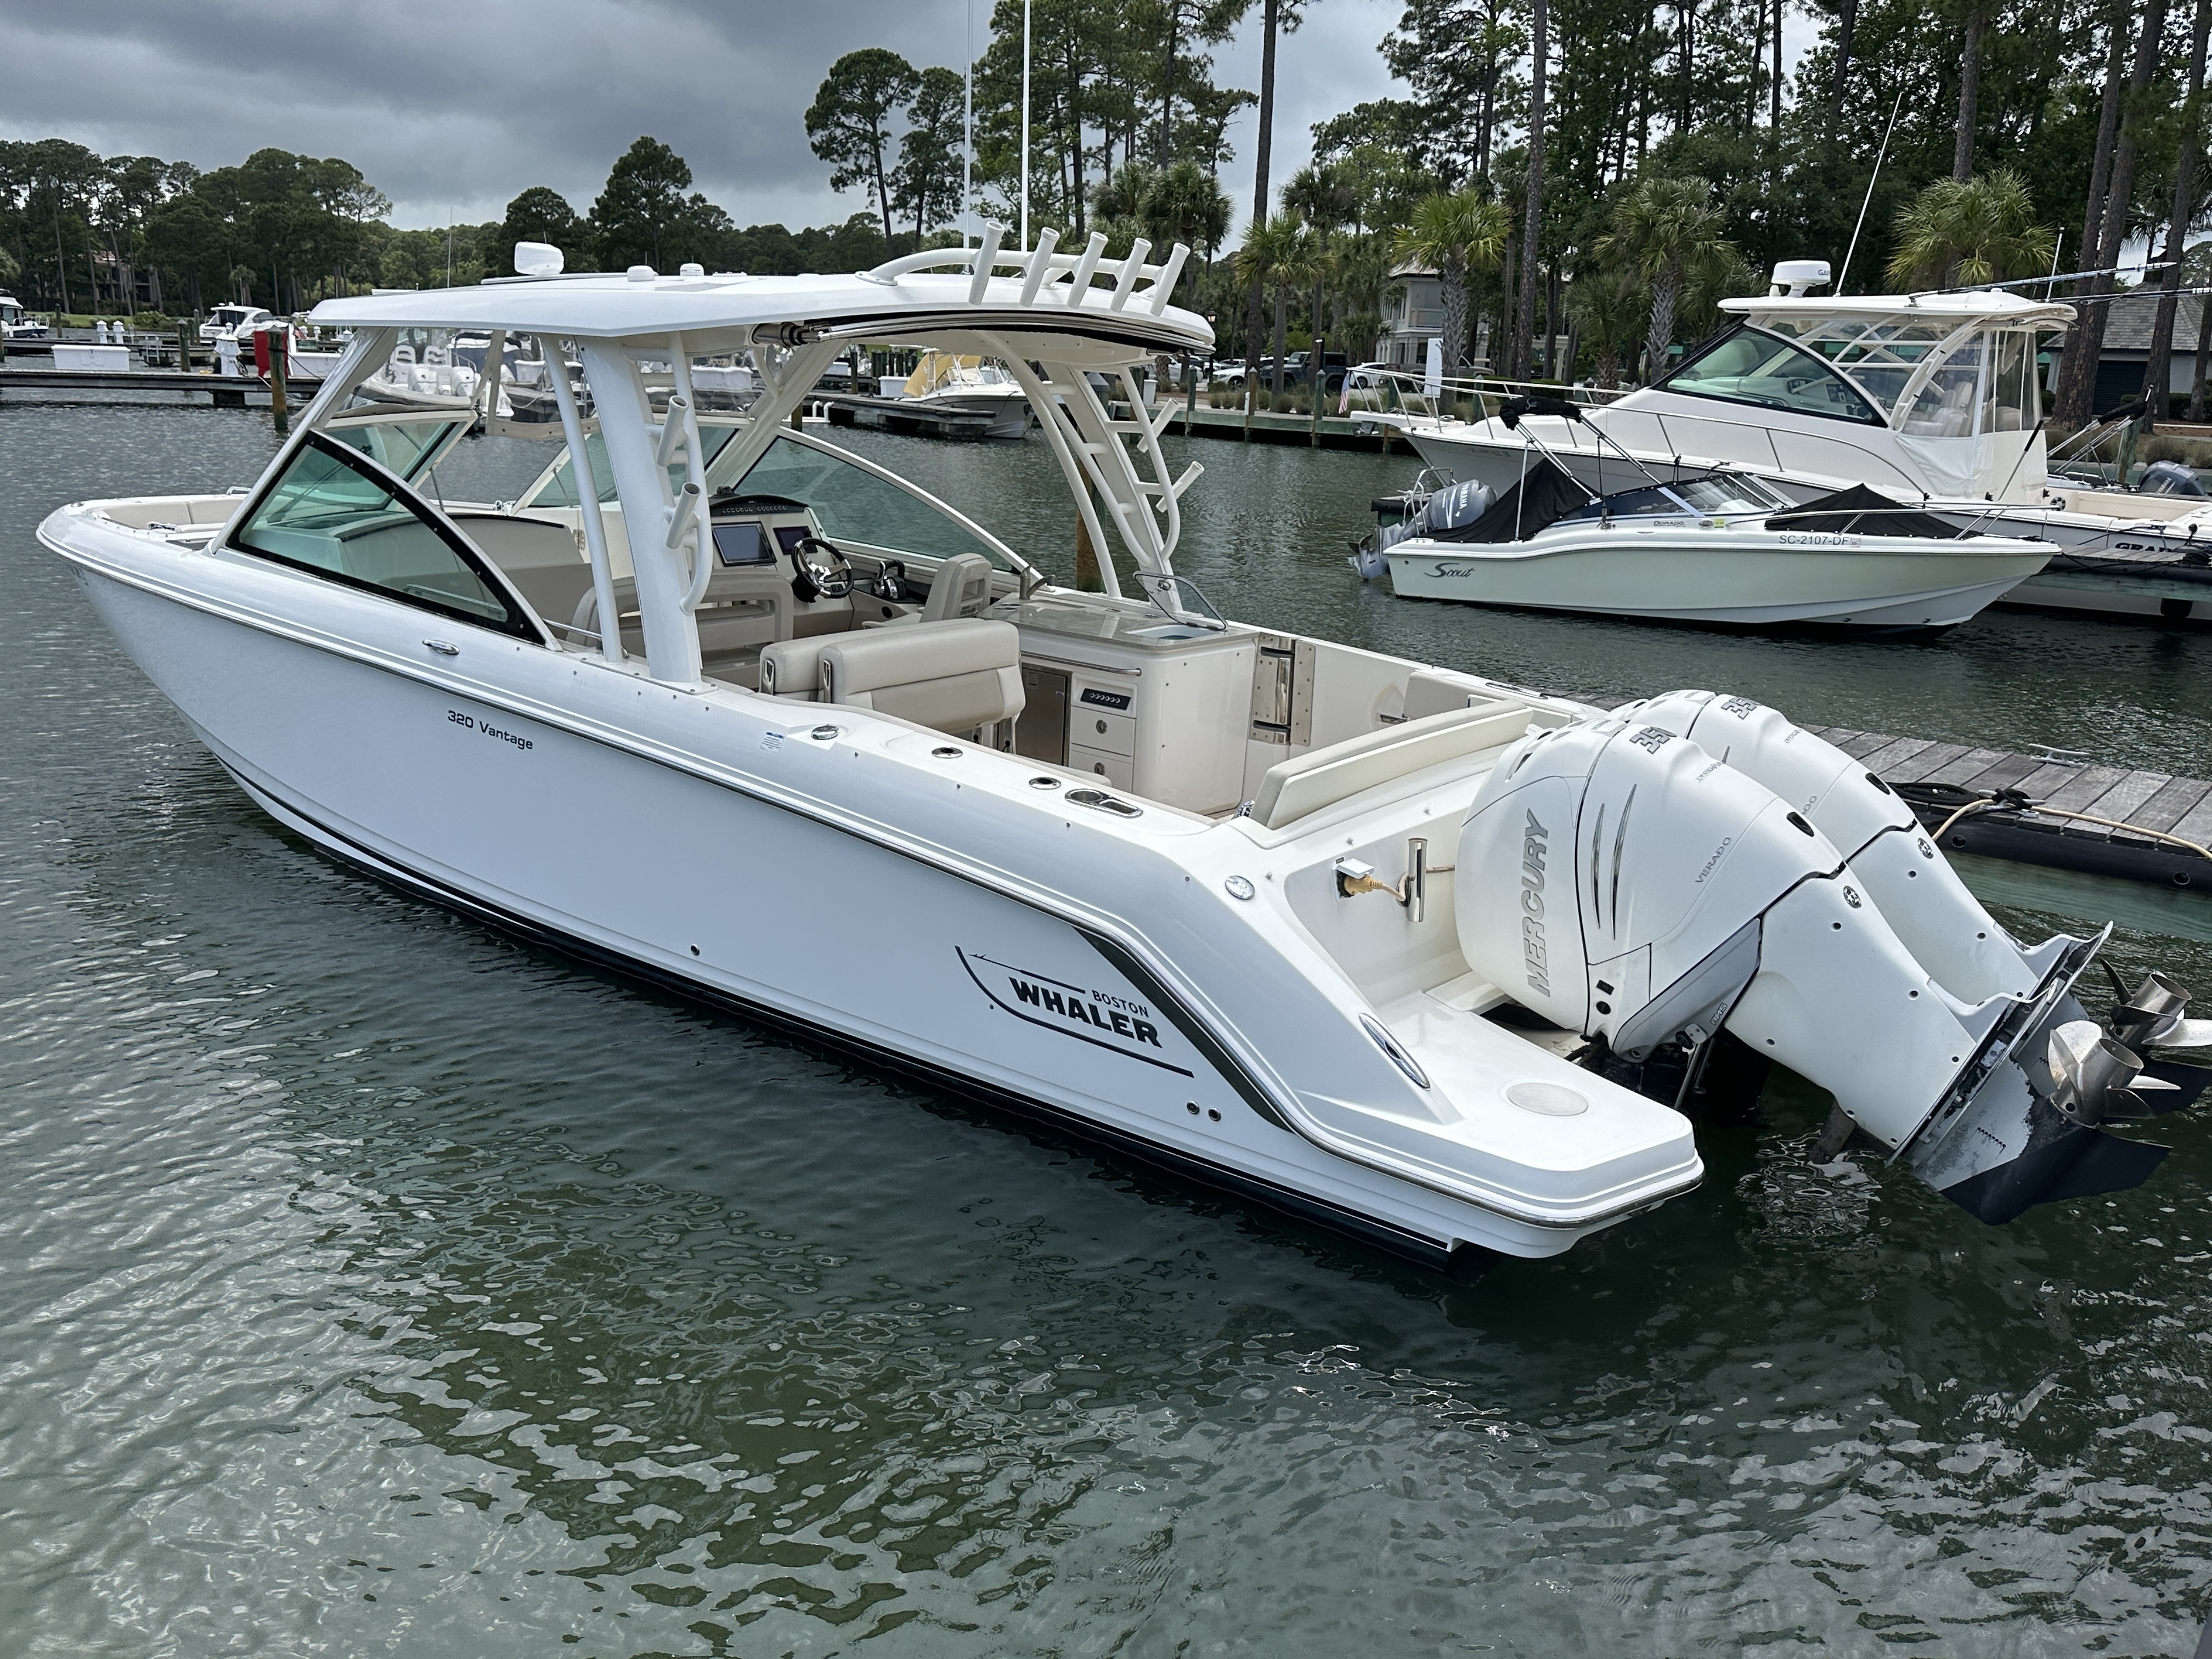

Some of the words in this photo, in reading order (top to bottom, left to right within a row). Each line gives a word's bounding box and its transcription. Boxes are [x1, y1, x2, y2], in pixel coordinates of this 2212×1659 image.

[1459, 483, 1469, 509] YAMAHA
[1779, 535, 1849, 545] SC-2107-DF
[1424, 562, 1476, 578] Scout
[448, 710, 473, 729] 320
[479, 721, 533, 750] Vantage
[1695, 836, 1731, 882] VERADO
[1521, 808, 1550, 997] MERCURY
[1008, 976, 1163, 1048] WHALER
[1092, 990, 1149, 1018] BOSTON
